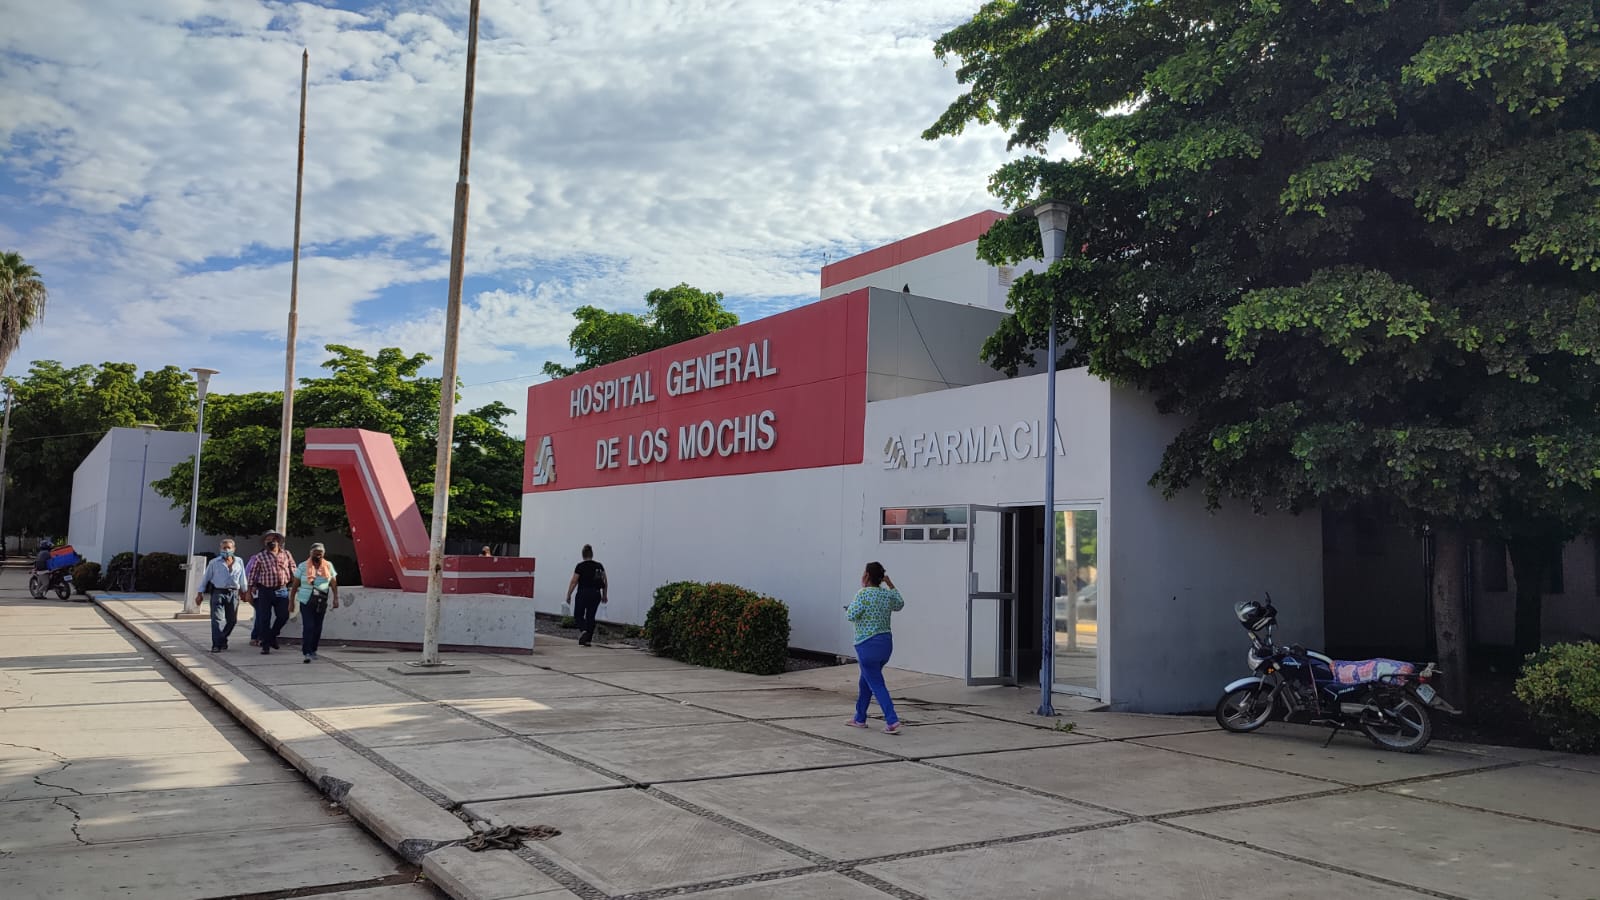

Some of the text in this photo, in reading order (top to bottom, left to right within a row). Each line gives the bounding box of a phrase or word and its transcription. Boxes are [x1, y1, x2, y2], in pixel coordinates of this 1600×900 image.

[569, 339, 777, 417] HOSPITAL GENERAL
[596, 410, 776, 470] DE LOS MOCHIS
[912, 419, 1066, 467] FARMACIA
